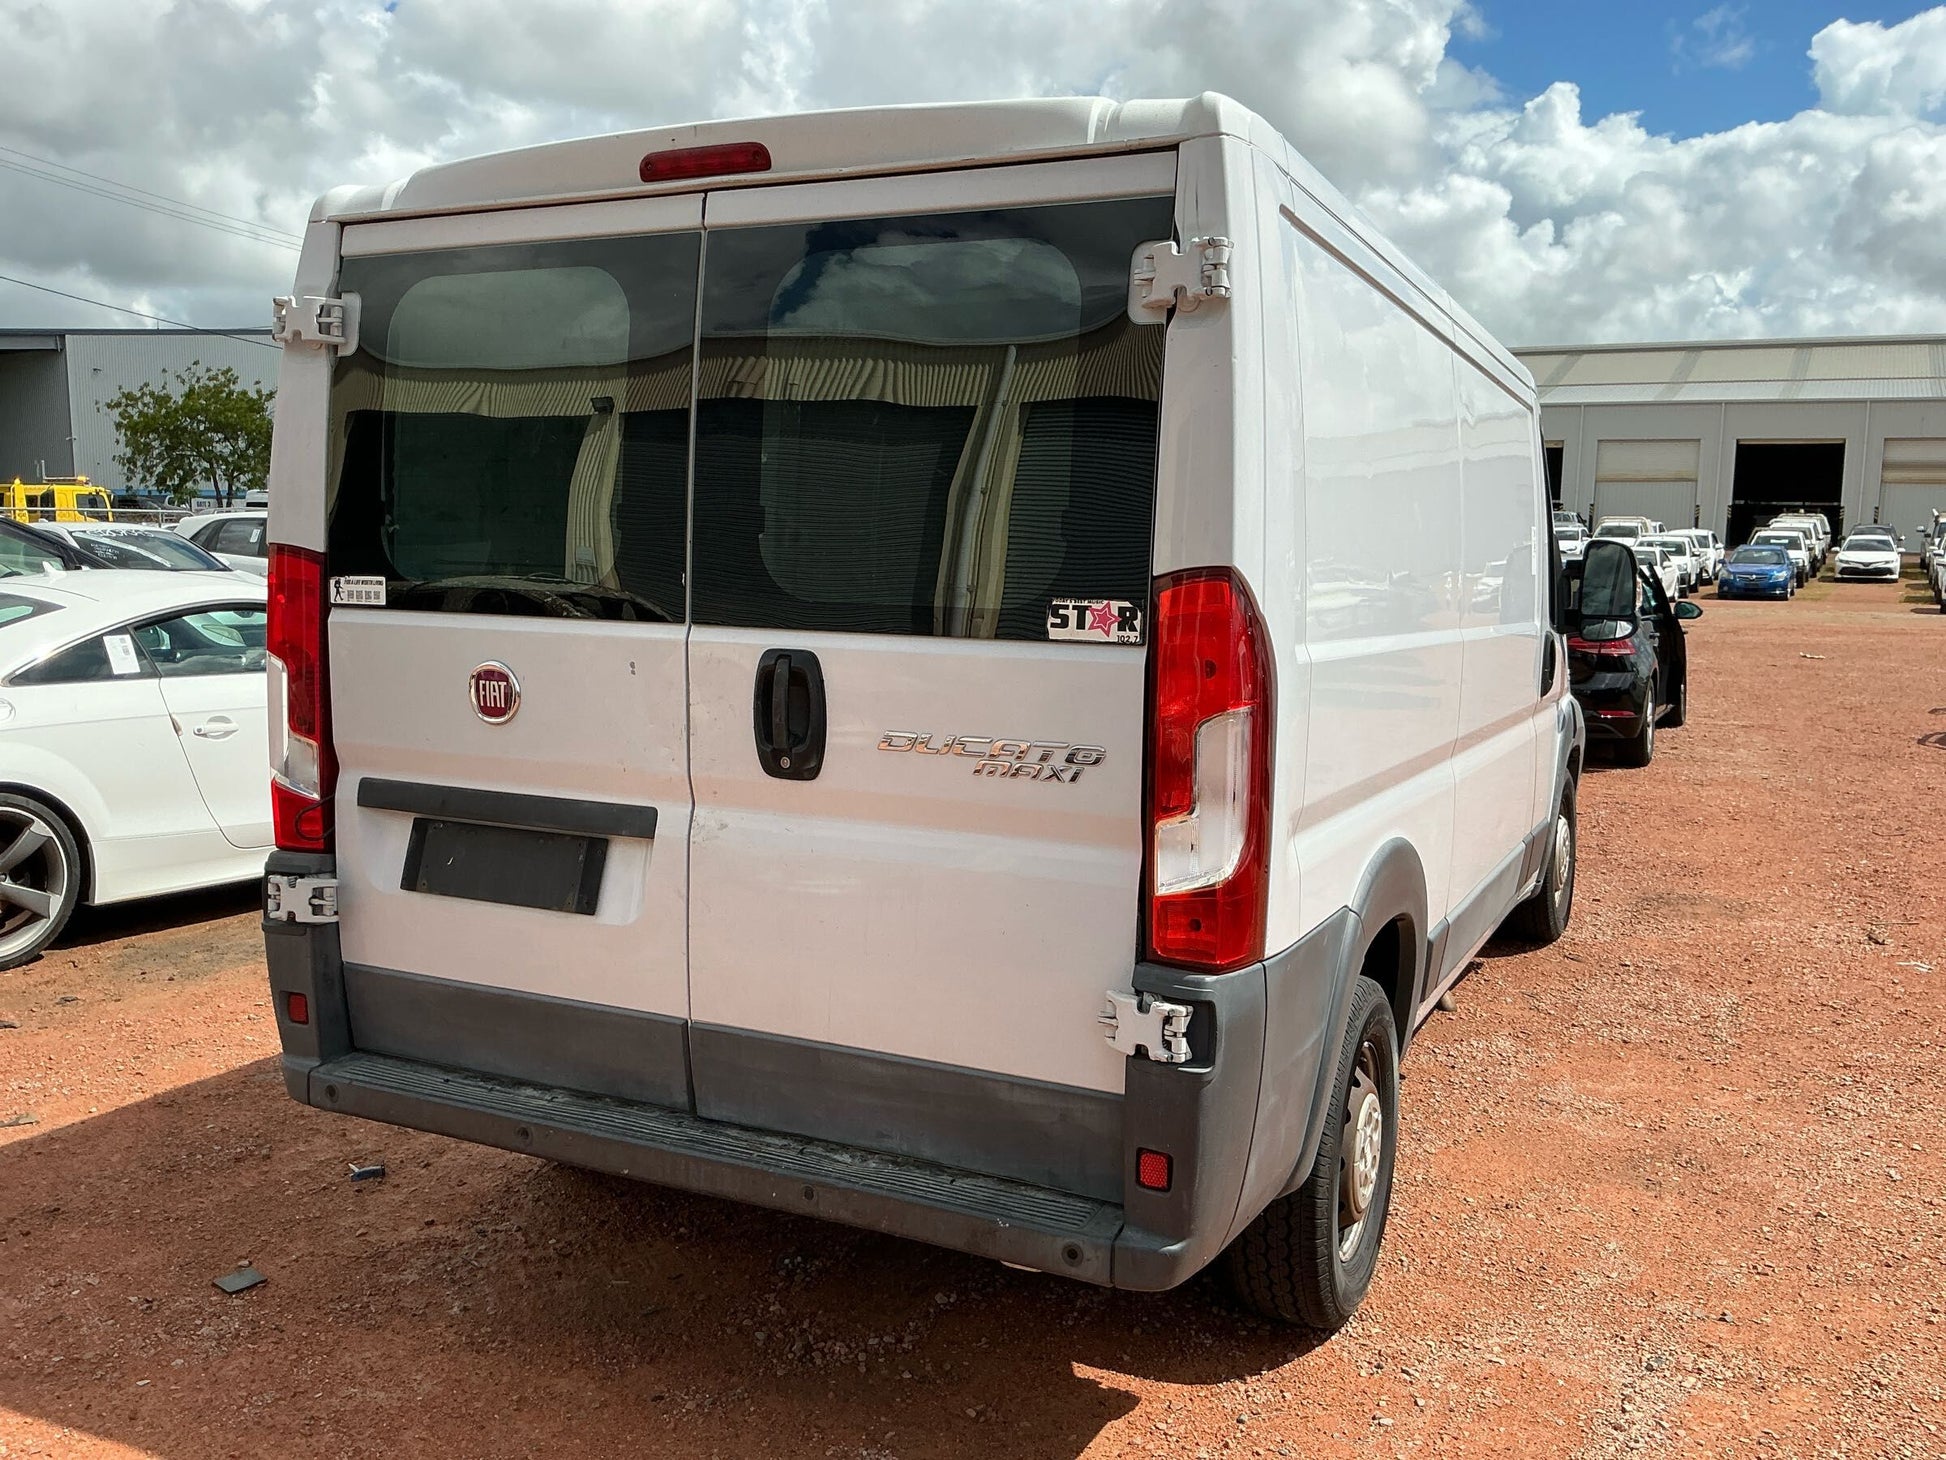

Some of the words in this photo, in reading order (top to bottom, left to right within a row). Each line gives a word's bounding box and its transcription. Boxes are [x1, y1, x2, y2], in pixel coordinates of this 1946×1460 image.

[1117, 635, 1138, 644] 102.7
[479, 680, 507, 708] FIAT
[877, 729, 1107, 767] DUCATO
[972, 759, 1085, 784] MAXI
